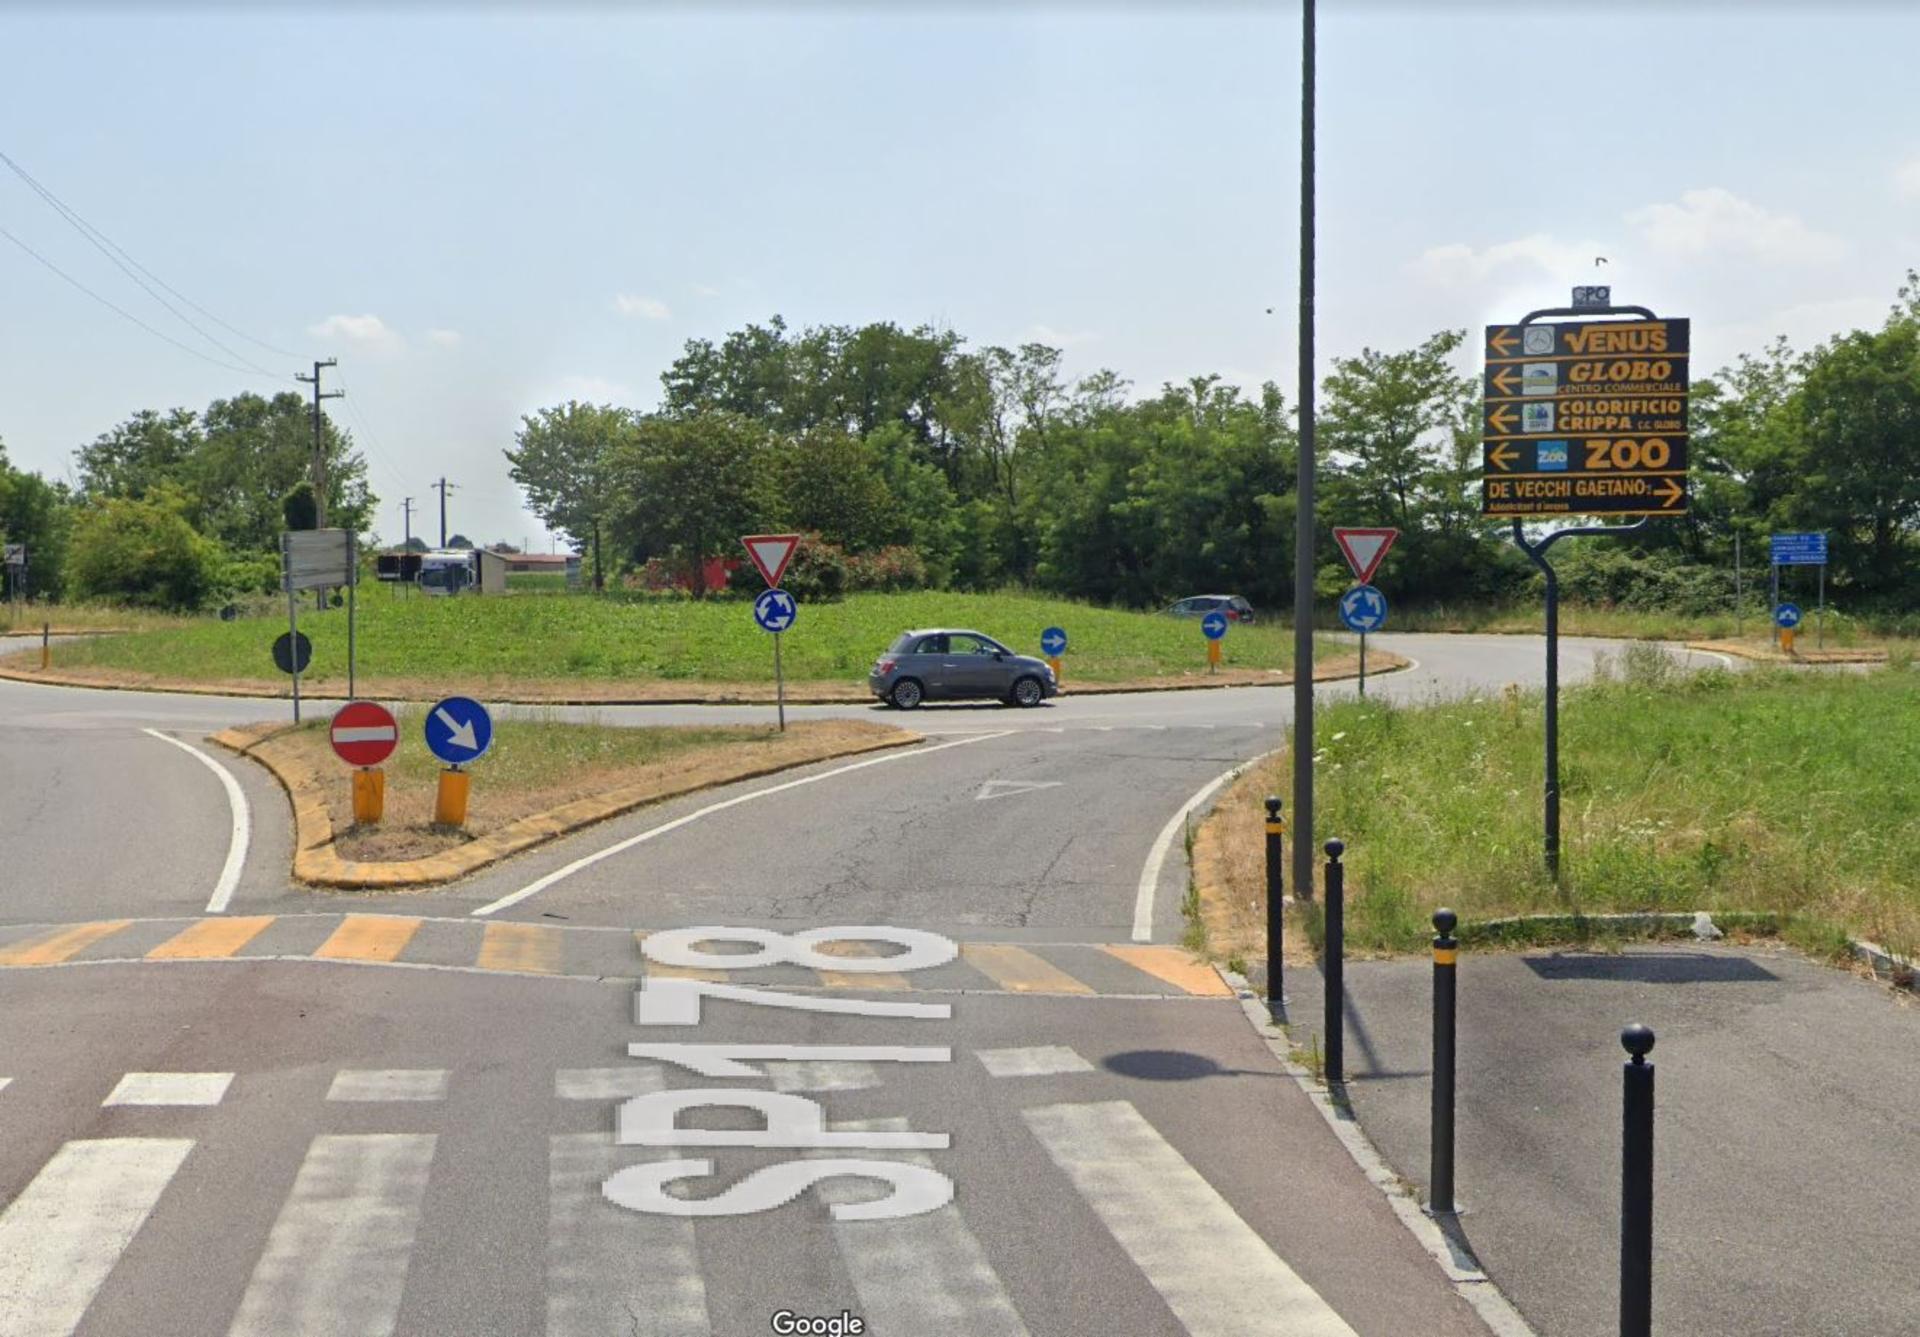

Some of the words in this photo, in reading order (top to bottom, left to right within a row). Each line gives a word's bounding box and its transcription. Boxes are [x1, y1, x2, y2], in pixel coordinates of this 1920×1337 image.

[1564, 323, 1668, 353] VENUS
[1568, 360, 1673, 383] GLOBO
[1558, 384, 1601, 394] CENTRO
[1558, 400, 1681, 415] COLORIFICIO
[1558, 416, 1632, 431] CRIPPA
[1584, 438, 1670, 469] ZOO
[1489, 482, 1511, 498] DE
[1515, 480, 1571, 497] VECCHI
[1576, 479, 1645, 497] GAETANO
